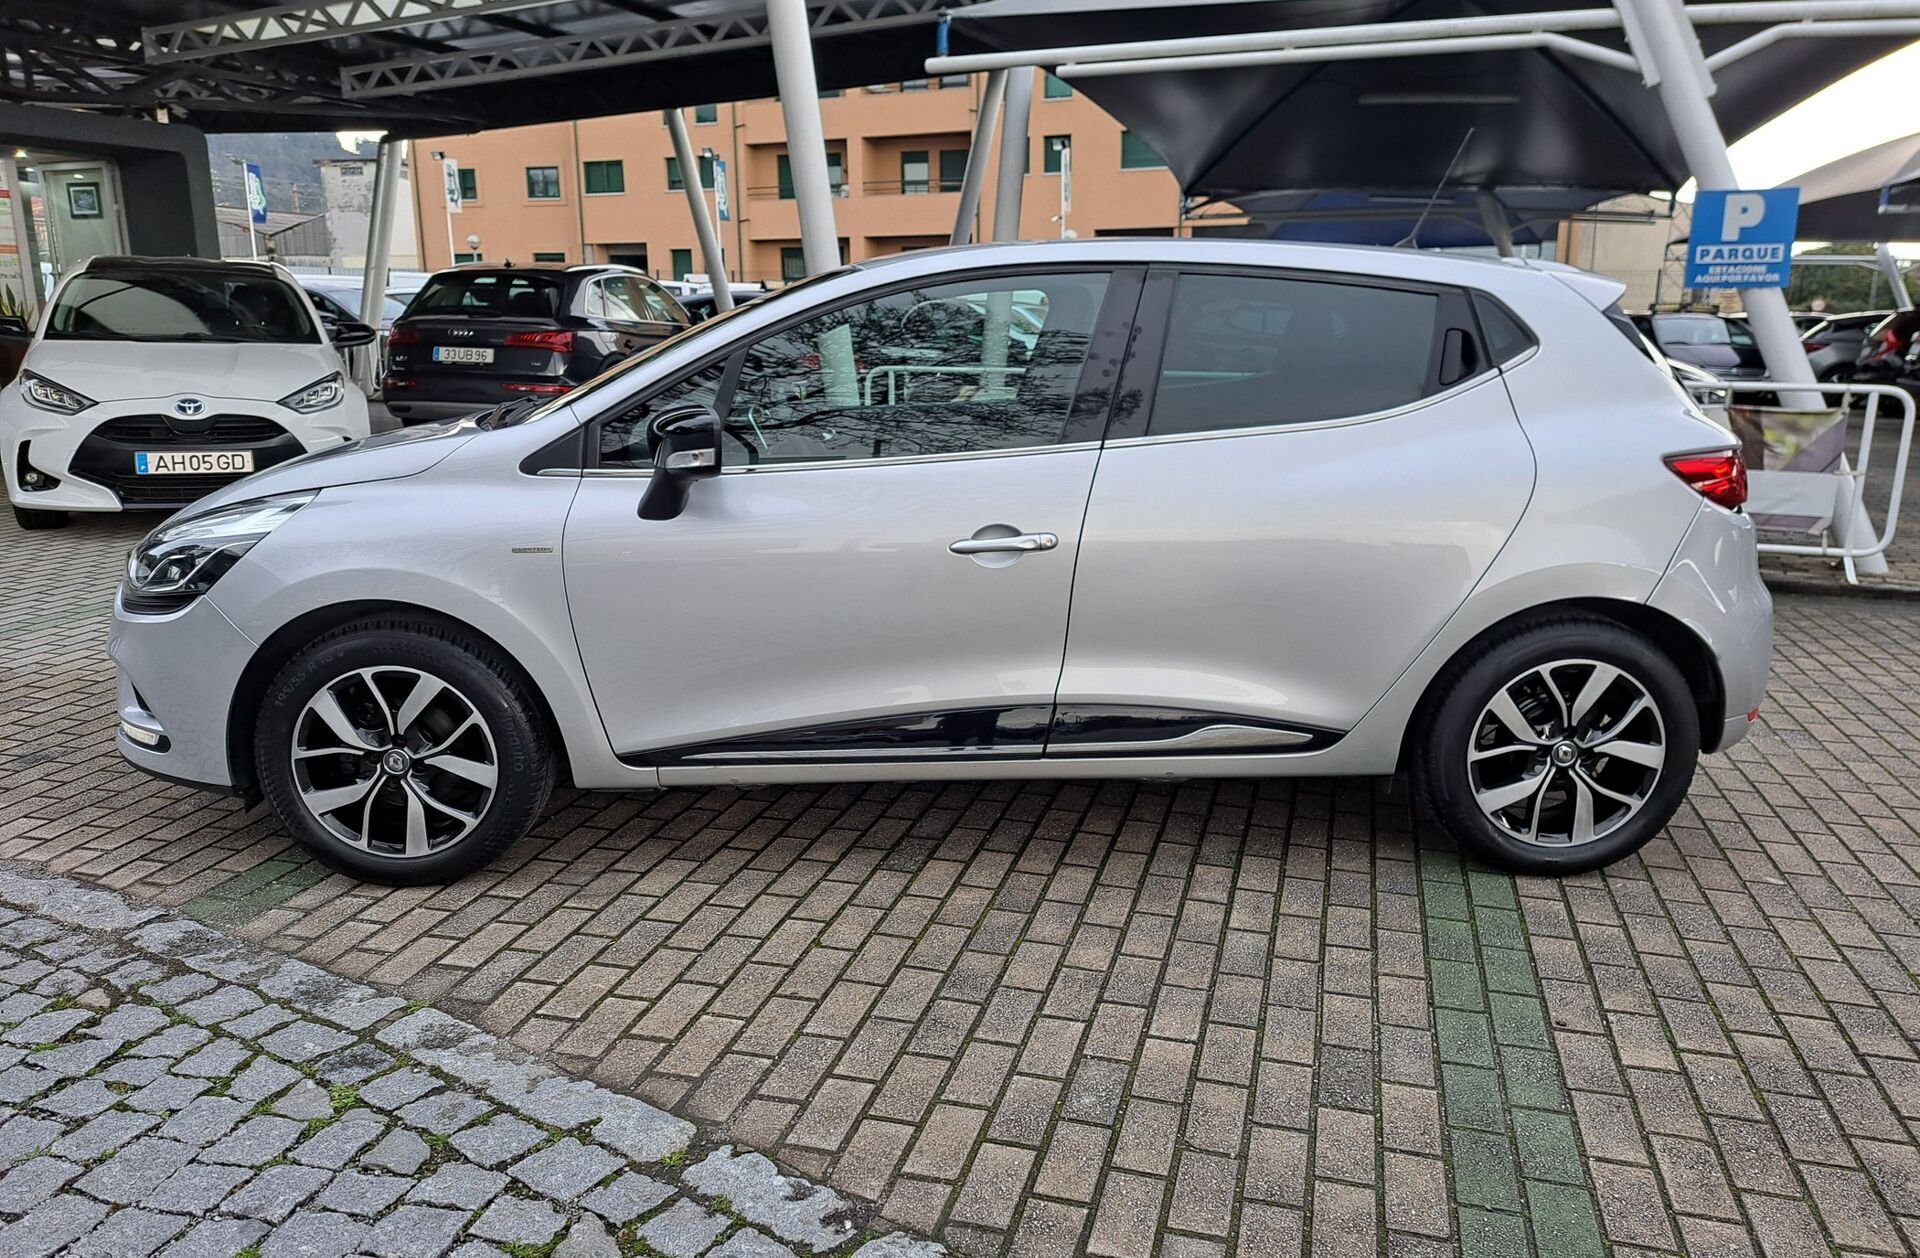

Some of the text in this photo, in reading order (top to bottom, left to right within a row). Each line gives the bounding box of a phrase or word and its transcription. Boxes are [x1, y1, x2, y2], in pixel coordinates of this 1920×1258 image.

[1721, 193, 1765, 242] P
[1700, 247, 1780, 260] PARQUE
[444, 349, 487, 361] 33UB96
[155, 454, 245, 471] AH05GD
